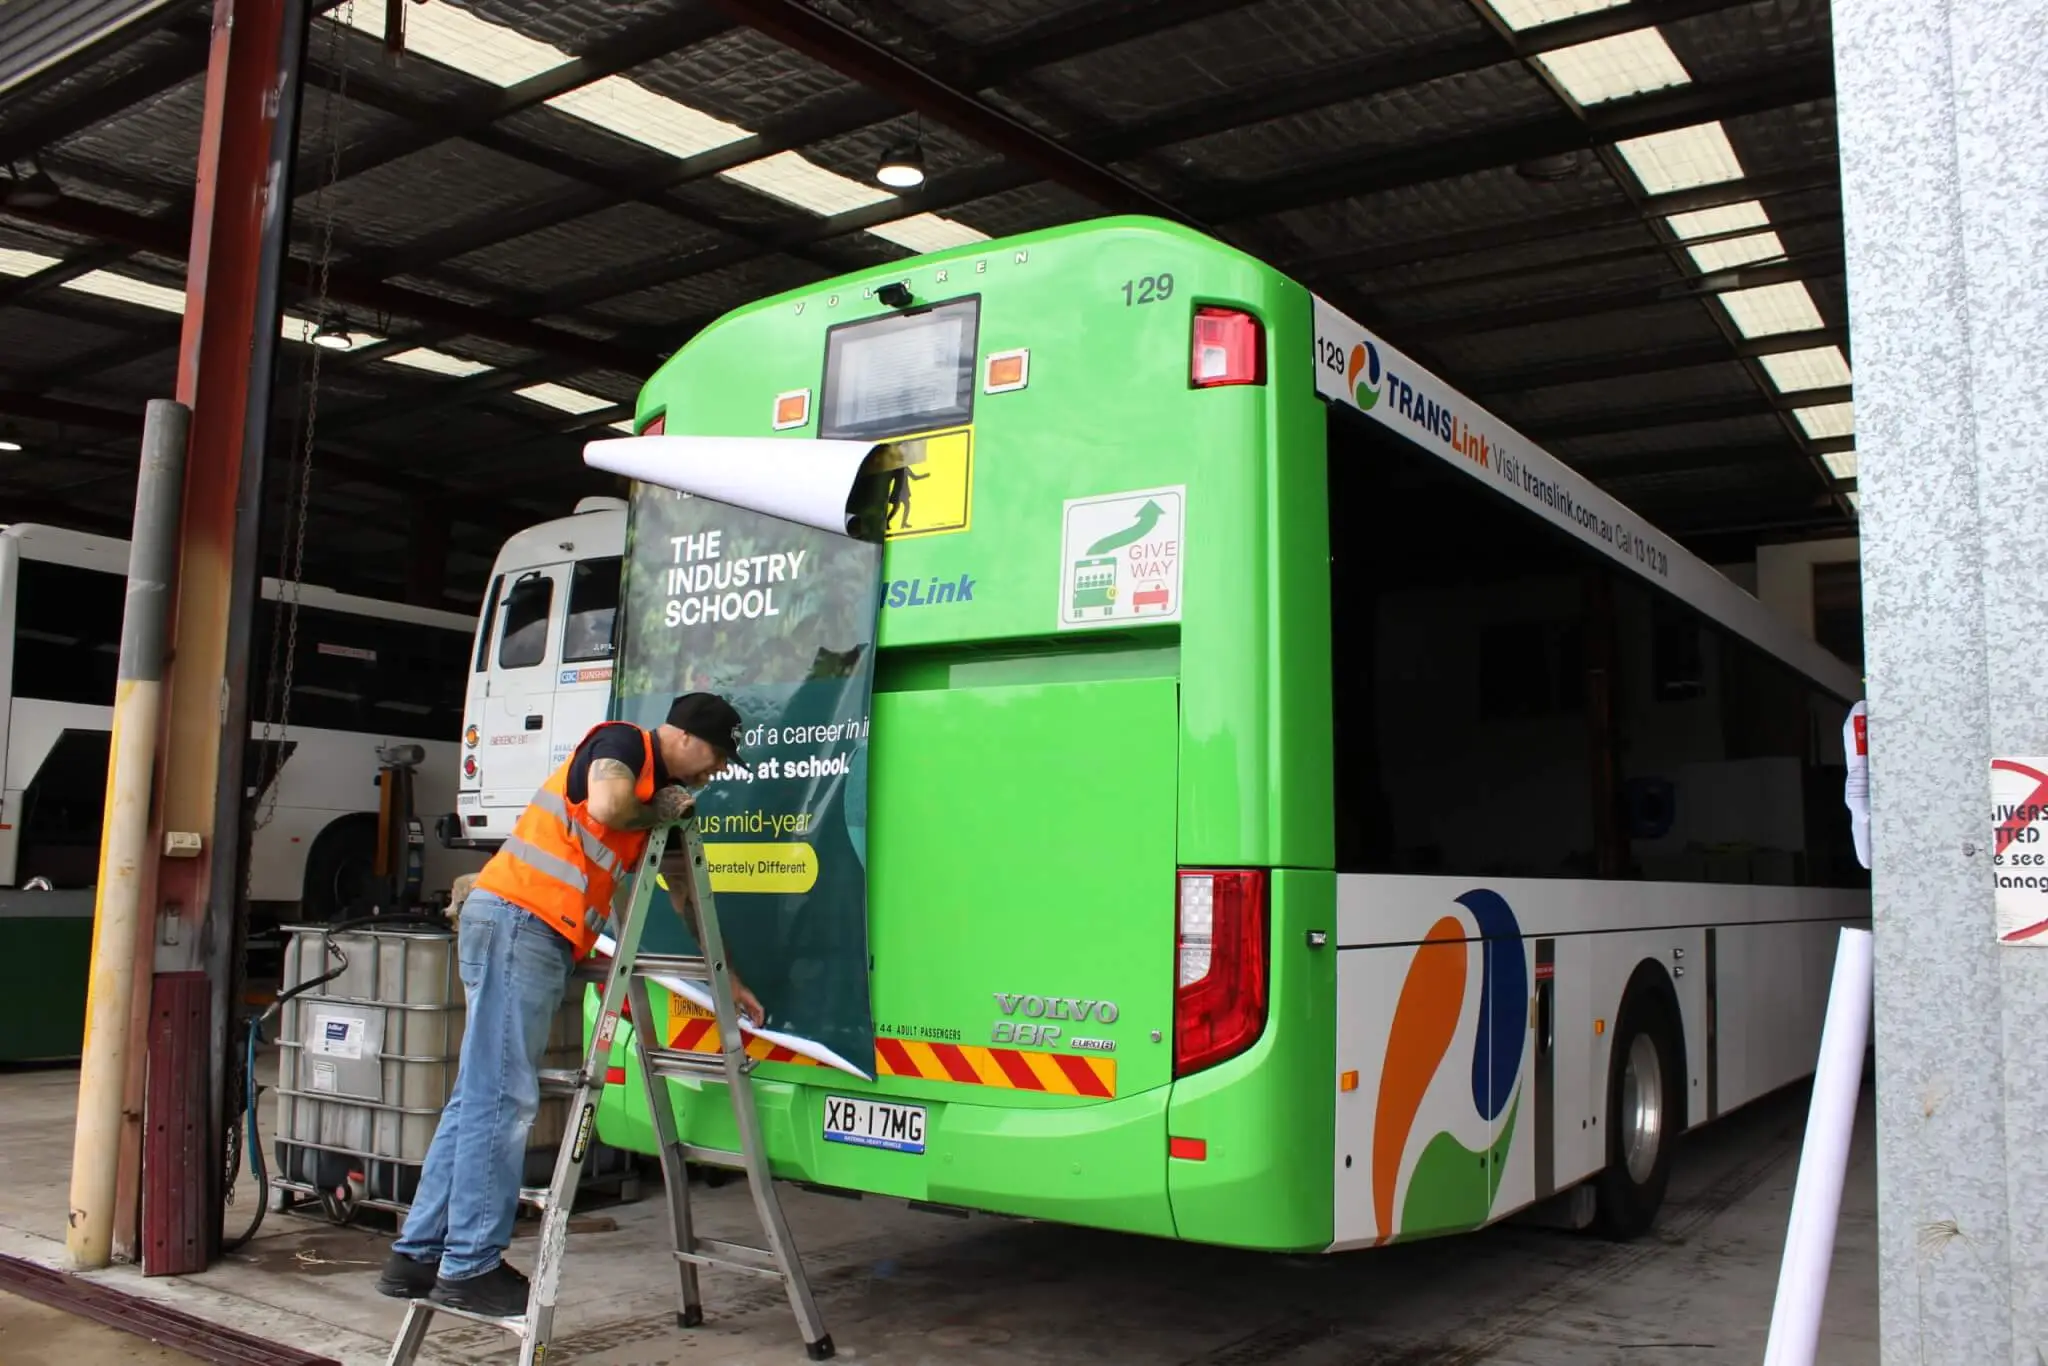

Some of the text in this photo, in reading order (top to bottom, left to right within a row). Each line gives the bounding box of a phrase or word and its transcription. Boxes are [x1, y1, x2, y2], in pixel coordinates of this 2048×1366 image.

[1121, 273, 1174, 307] 129
[1317, 336, 1345, 375] 129
[1386, 371, 1490, 469] TRANSLink
[1492, 443, 1520, 487] Visit
[1523, 464, 1613, 543] translink.com.au
[1615, 524, 1632, 555] Call
[1634, 536, 1645, 562] 13
[670, 530, 722, 564] THE
[1128, 540, 1177, 560] GIVE
[667, 550, 806, 596] INDUSTRY
[1130, 559, 1174, 578] WAY
[664, 588, 779, 628] SCHOOL
[745, 724, 764, 747] of
[767, 729, 778, 745] a
[783, 724, 845, 744] career
[845, 718, 859, 739] in
[758, 757, 779, 779] at
[783, 752, 849, 778] school.
[698, 809, 812, 839] us mid-year
[708, 860, 806, 876] berately Different
[2011, 853, 2045, 865] see
[993, 992, 1119, 1024] VOLVO
[897, 1025, 917, 1037] ADULT
[920, 1026, 961, 1041] PASSENGERS
[991, 1021, 1062, 1048] B8R
[1072, 1038, 1100, 1049] EURO
